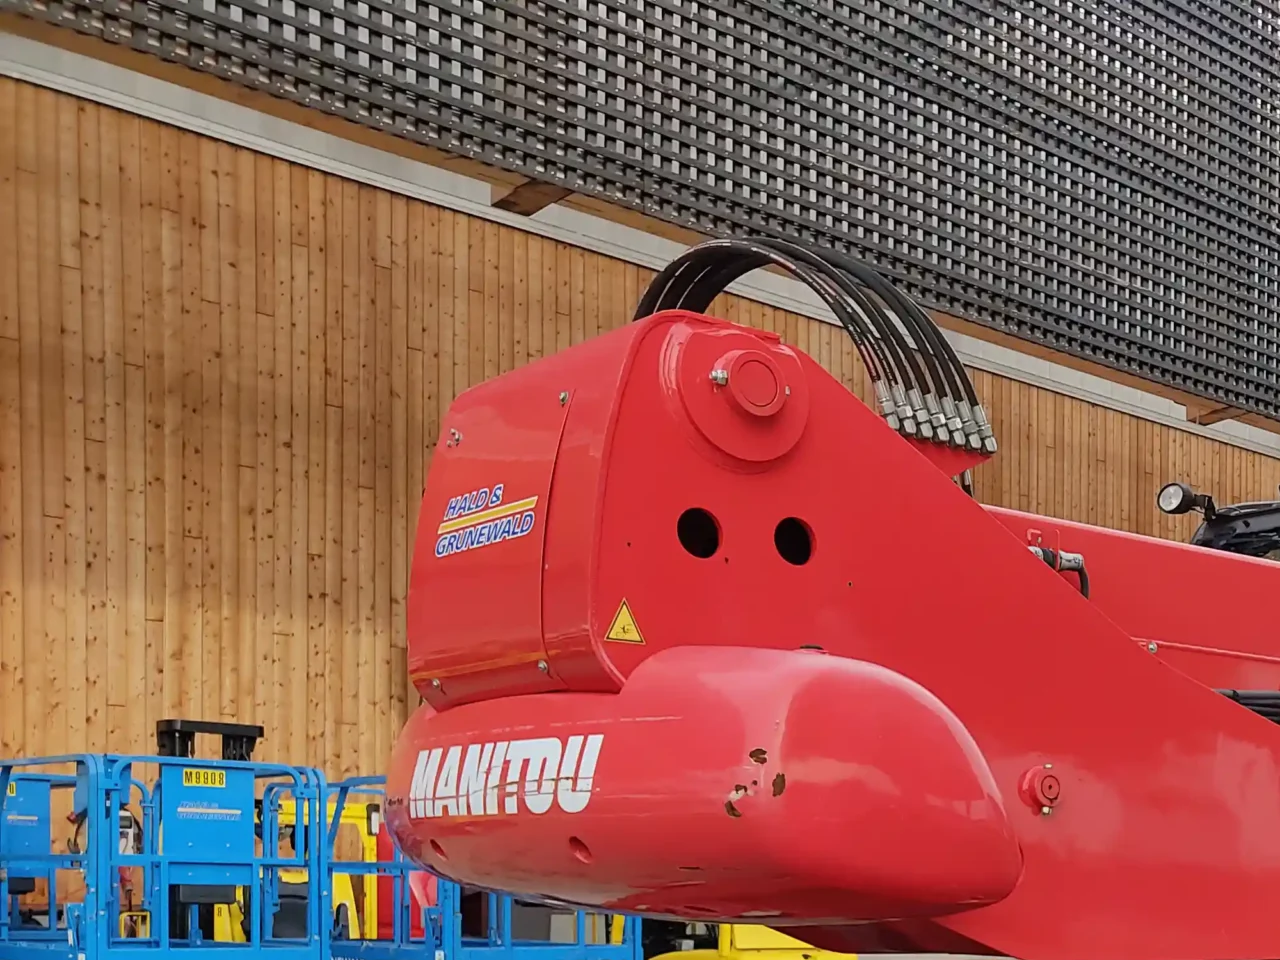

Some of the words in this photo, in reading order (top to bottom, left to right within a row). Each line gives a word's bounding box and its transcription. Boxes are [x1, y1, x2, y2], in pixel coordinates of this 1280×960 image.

[443, 486, 490, 520] HALD
[487, 483, 505, 507] &
[435, 511, 535, 558] GRUNEWALD
[409, 734, 605, 819] MANITOU
